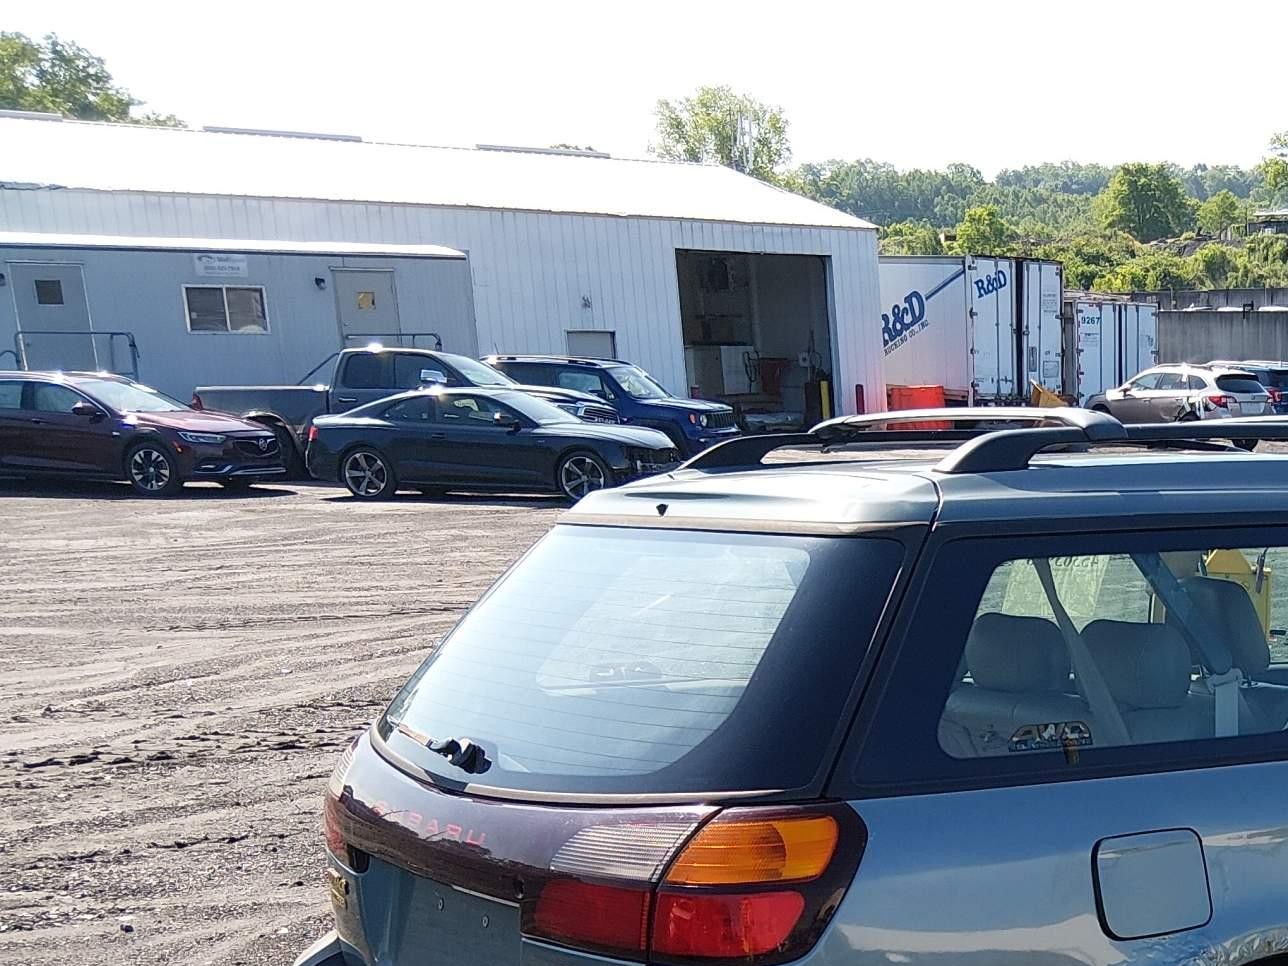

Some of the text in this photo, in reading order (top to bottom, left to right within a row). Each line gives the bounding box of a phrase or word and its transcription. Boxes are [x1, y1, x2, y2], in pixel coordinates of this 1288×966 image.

[974, 270, 1007, 299] R&D
[881, 291, 925, 348] R&D
[1081, 316, 1101, 325] 9267
[371, 799, 487, 846] SBARU
